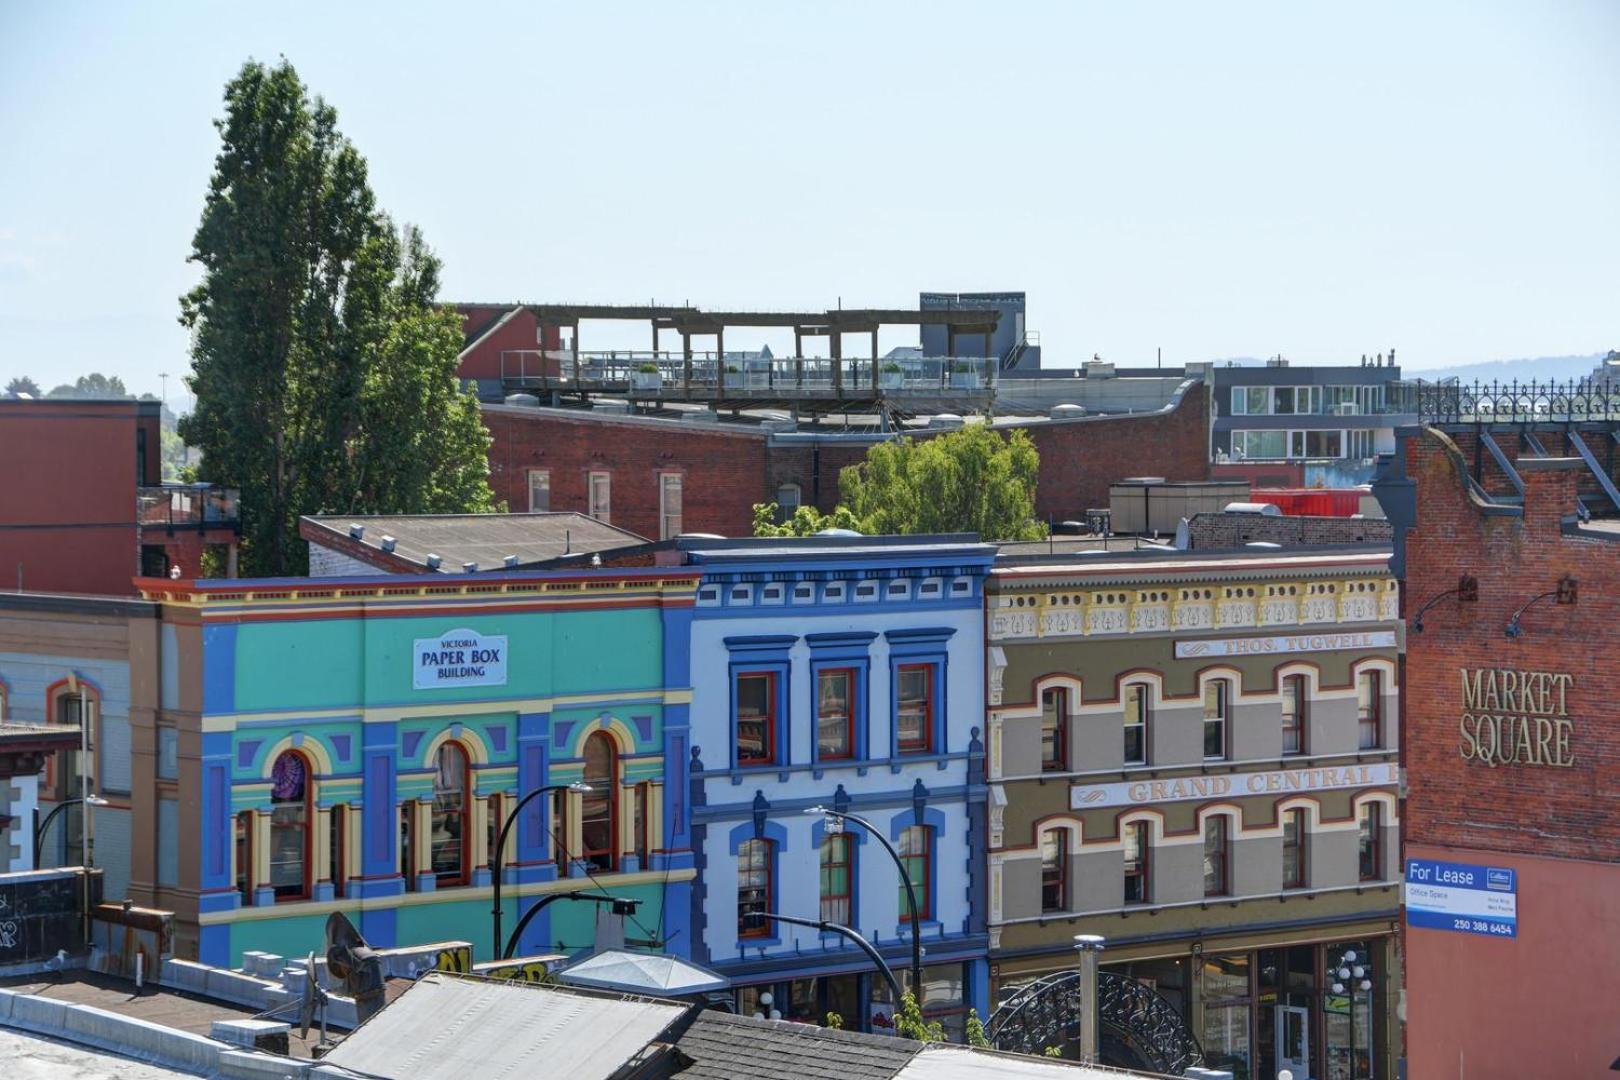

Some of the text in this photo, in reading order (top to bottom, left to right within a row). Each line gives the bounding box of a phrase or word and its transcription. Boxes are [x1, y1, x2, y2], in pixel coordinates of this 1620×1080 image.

[441, 640, 478, 648] VICTORIA
[1224, 633, 1374, 655] THOS. TUGWELL
[422, 649, 500, 666] PAPER BOX
[438, 666, 485, 678] BUILDING
[1460, 668, 1574, 716] MARKET
[1459, 713, 1575, 768] SQUARE
[1127, 775, 1232, 802] GRAND
[1246, 765, 1374, 794] CENTRAL
[1409, 863, 1474, 885] For Lease
[1454, 919, 1512, 935] 250 388 6454
